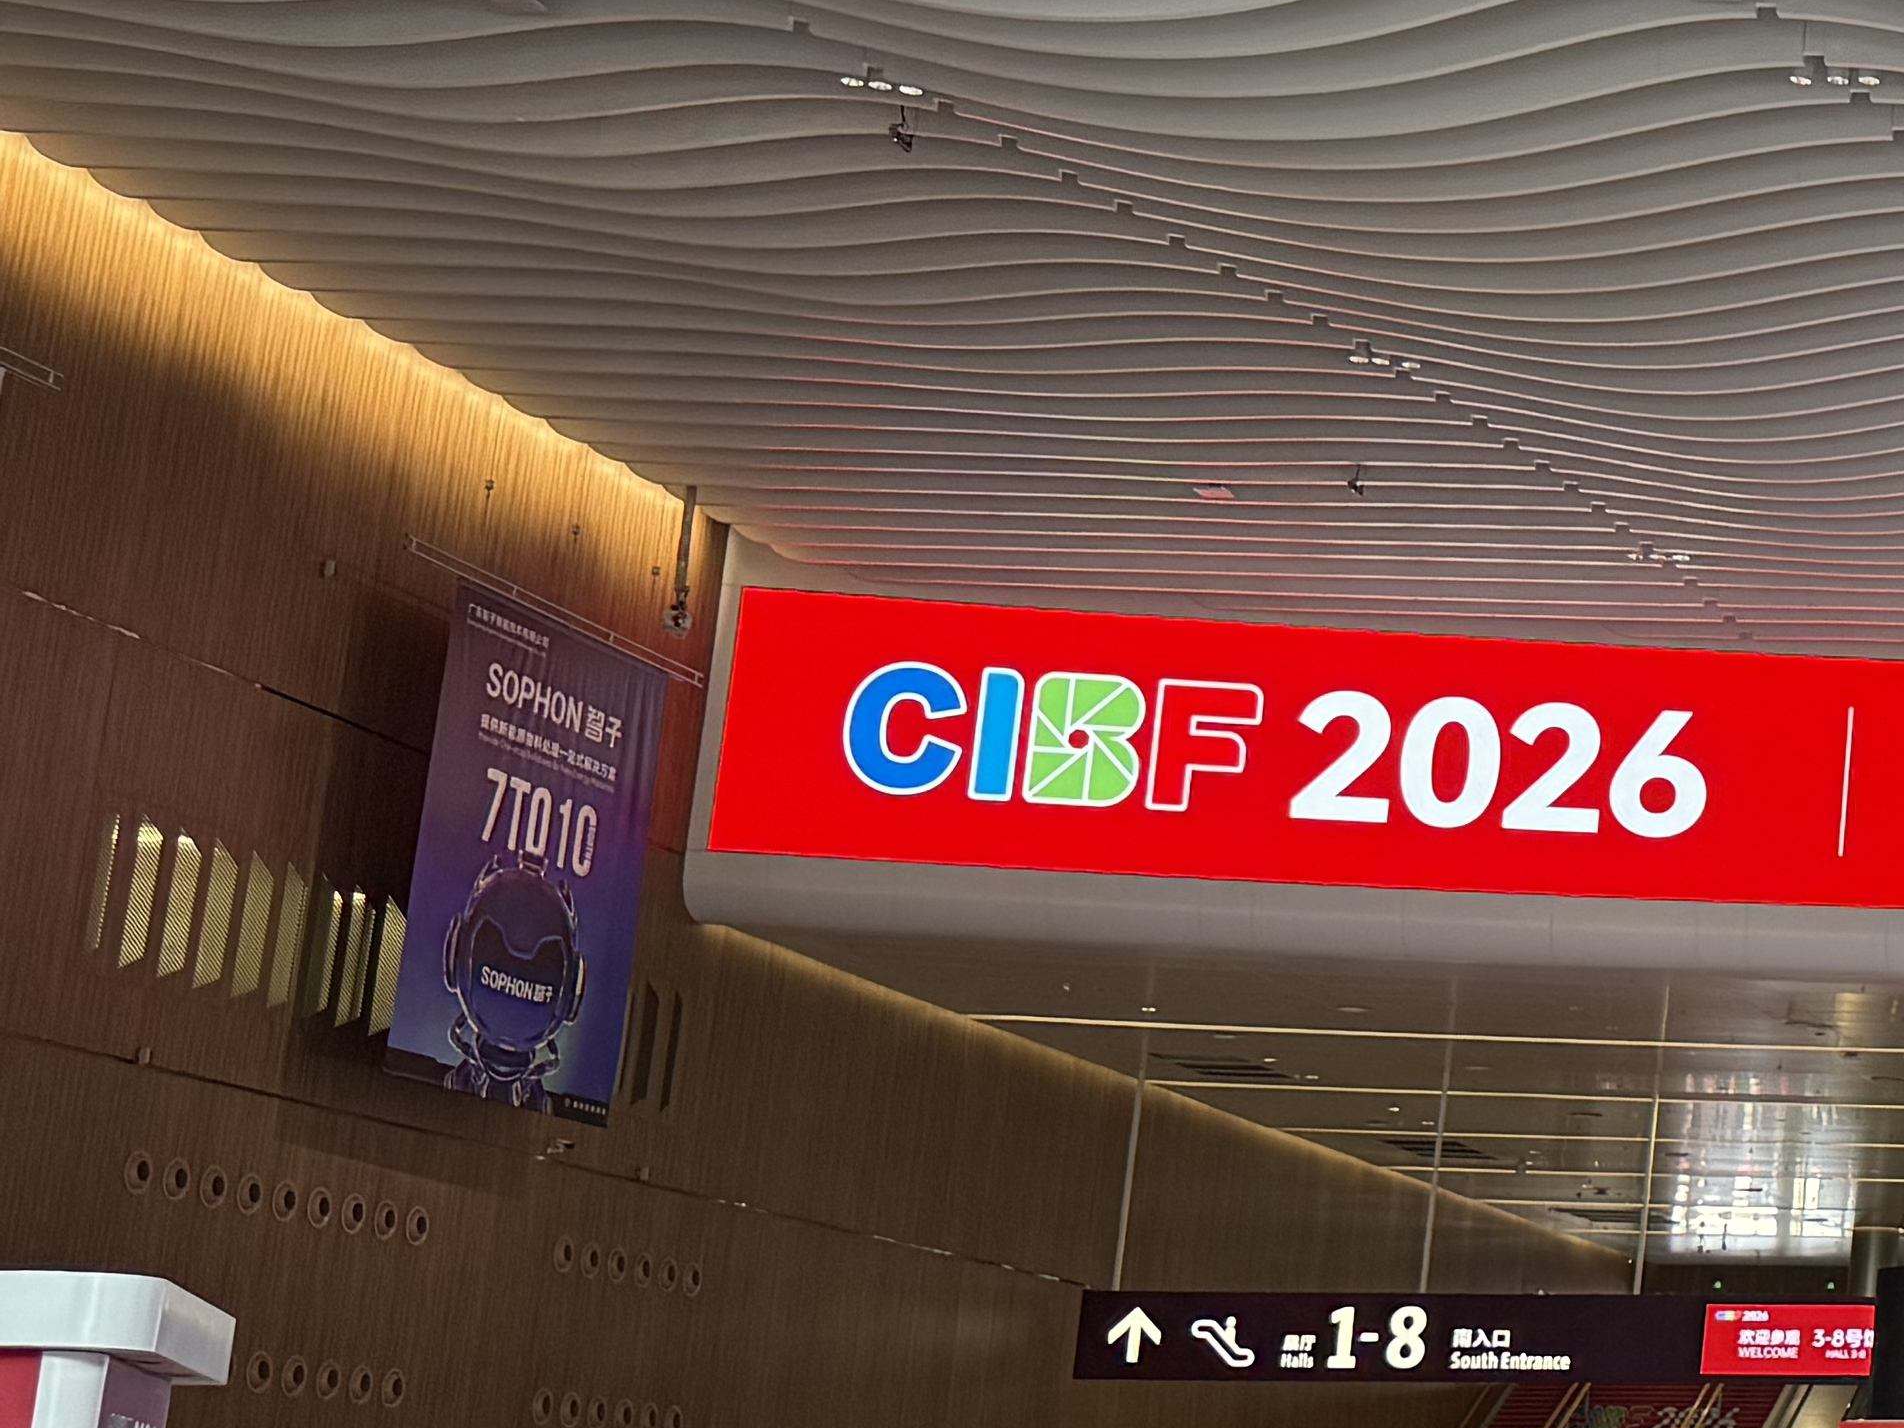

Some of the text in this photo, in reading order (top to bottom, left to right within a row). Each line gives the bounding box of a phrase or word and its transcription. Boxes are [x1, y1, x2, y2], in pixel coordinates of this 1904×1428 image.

[486, 663, 622, 748] SOPHON 智子
[842, 660, 1708, 839] CIBF 2026
[481, 965, 533, 1001] SOPHON
[1326, 1305, 1427, 1370] 1-8
[1452, 1329, 1511, 1349] 南入口
[1280, 1353, 1314, 1369] Halls
[1449, 1352, 1571, 1371] South Entrance
[1738, 1346, 1798, 1359] WELCOME
